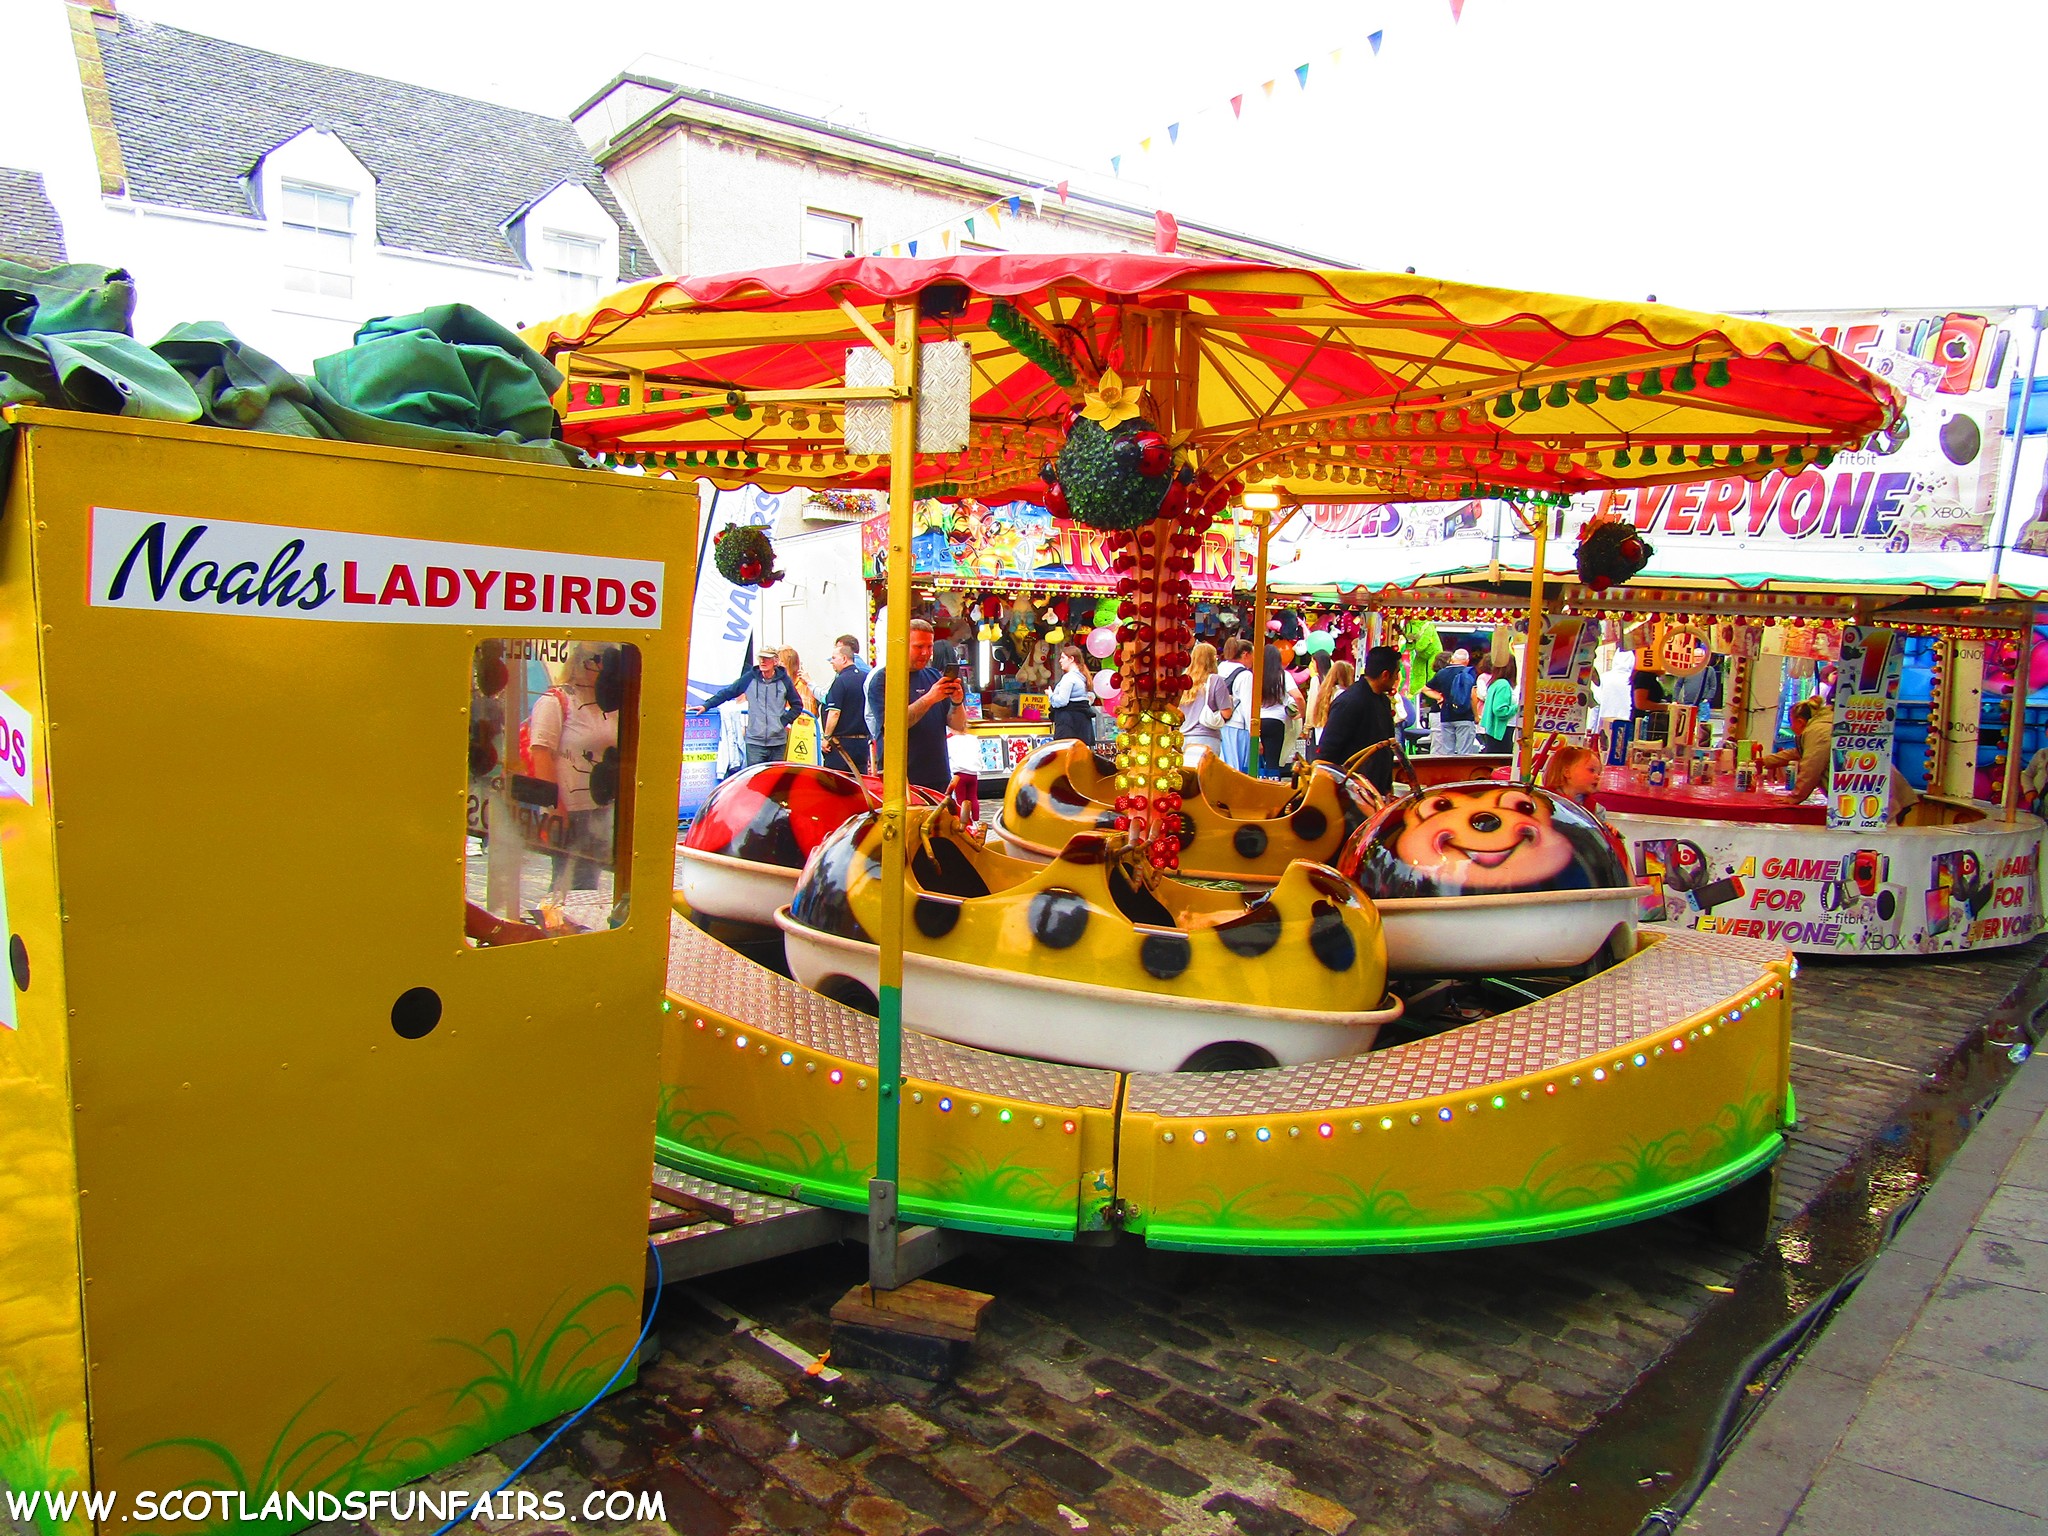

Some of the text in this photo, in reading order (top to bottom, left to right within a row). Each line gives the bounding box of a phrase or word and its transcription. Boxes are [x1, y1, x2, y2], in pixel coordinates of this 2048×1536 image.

[1839, 452, 1877, 465] fitbit
[1422, 505, 1446, 516] XBOX
[1596, 471, 1917, 538] EVERYONE
[1931, 507, 1972, 519] XBOX
[107, 521, 657, 618] Noahs LADYBIRDS
[1858, 629, 1895, 694] 1
[1538, 706, 1569, 718] THE
[1844, 710, 1887, 722] OVER
[685, 718, 711, 728] ATER
[1534, 719, 1580, 732] LOCK
[1850, 723, 1878, 734] THE
[685, 729, 718, 739] LKERS
[1836, 737, 1888, 750] BLOCK
[682, 754, 695, 762] ETY
[1845, 752, 1877, 772] TO
[1832, 773, 1886, 793] WIN!
[1737, 856, 1842, 882] A GAME
[1750, 888, 1805, 911] FOR
[1993, 886, 2024, 909] FOR
[1835, 913, 1865, 925] fitbit
[1696, 915, 1842, 945] EVERYONE
[1861, 933, 1906, 950] XBOX
